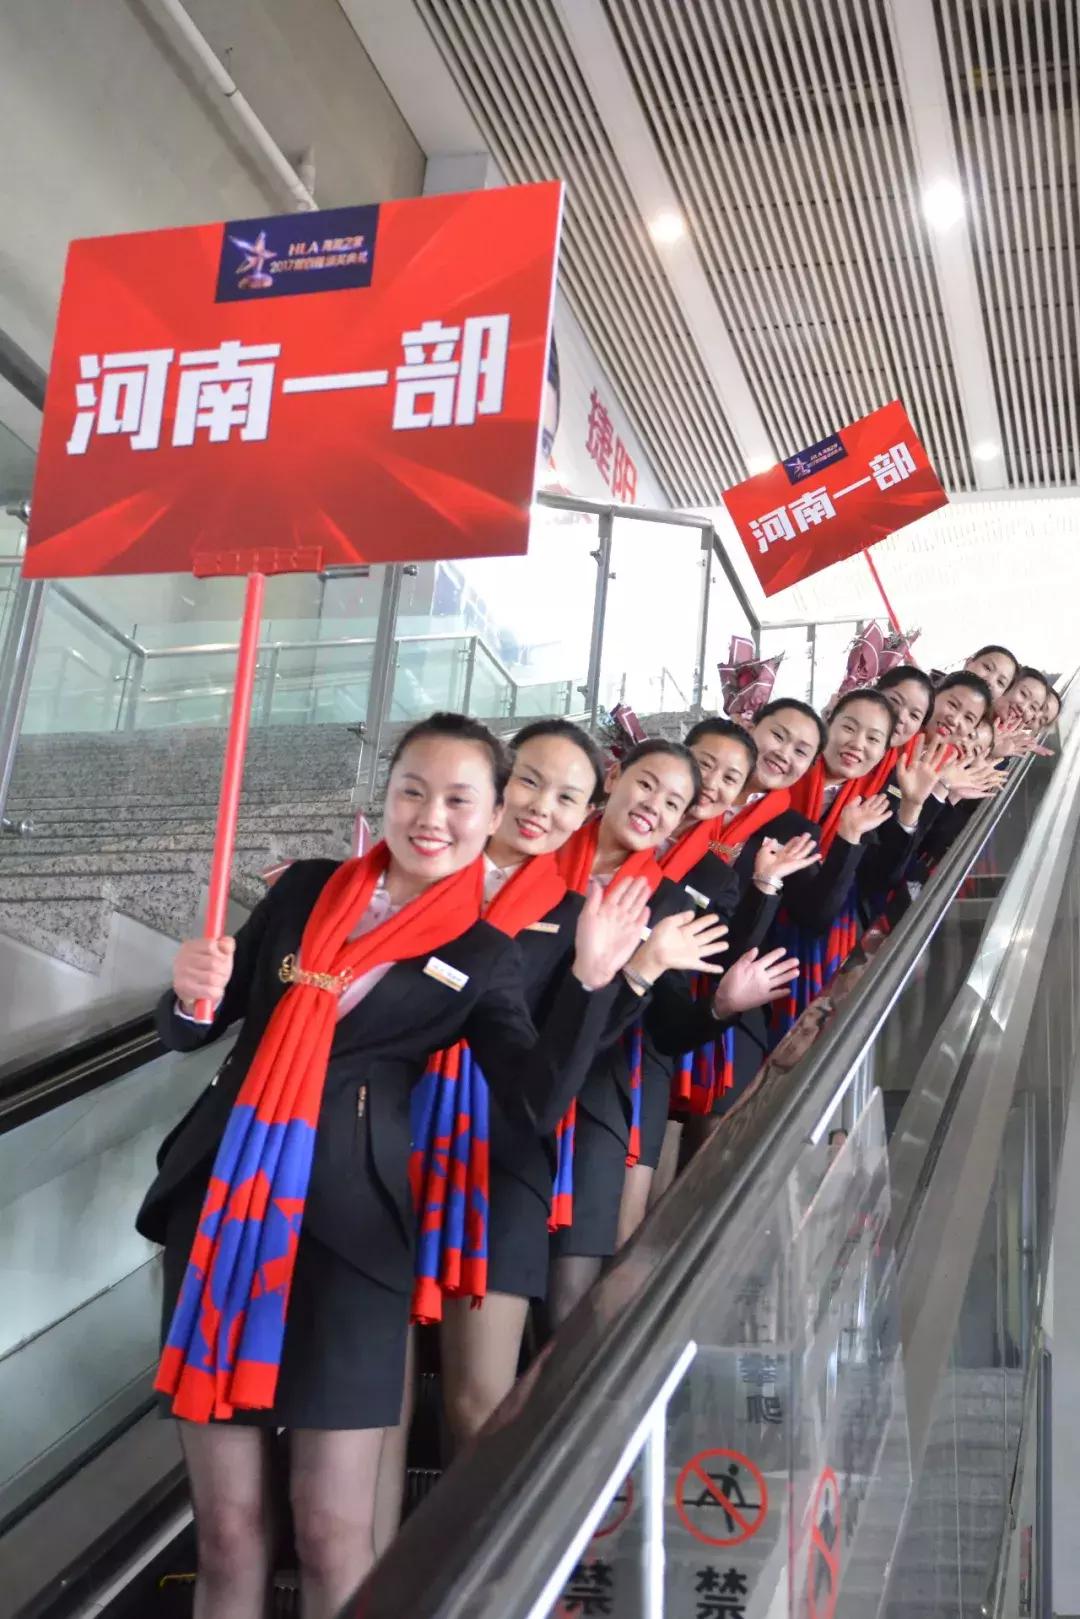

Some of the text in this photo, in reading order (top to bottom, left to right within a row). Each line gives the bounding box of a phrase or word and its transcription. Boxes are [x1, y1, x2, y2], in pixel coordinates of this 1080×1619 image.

[66, 313, 511, 455] 河南一部
[748, 441, 917, 554] 河南一部
[695, 1566, 748, 1619] 禁
